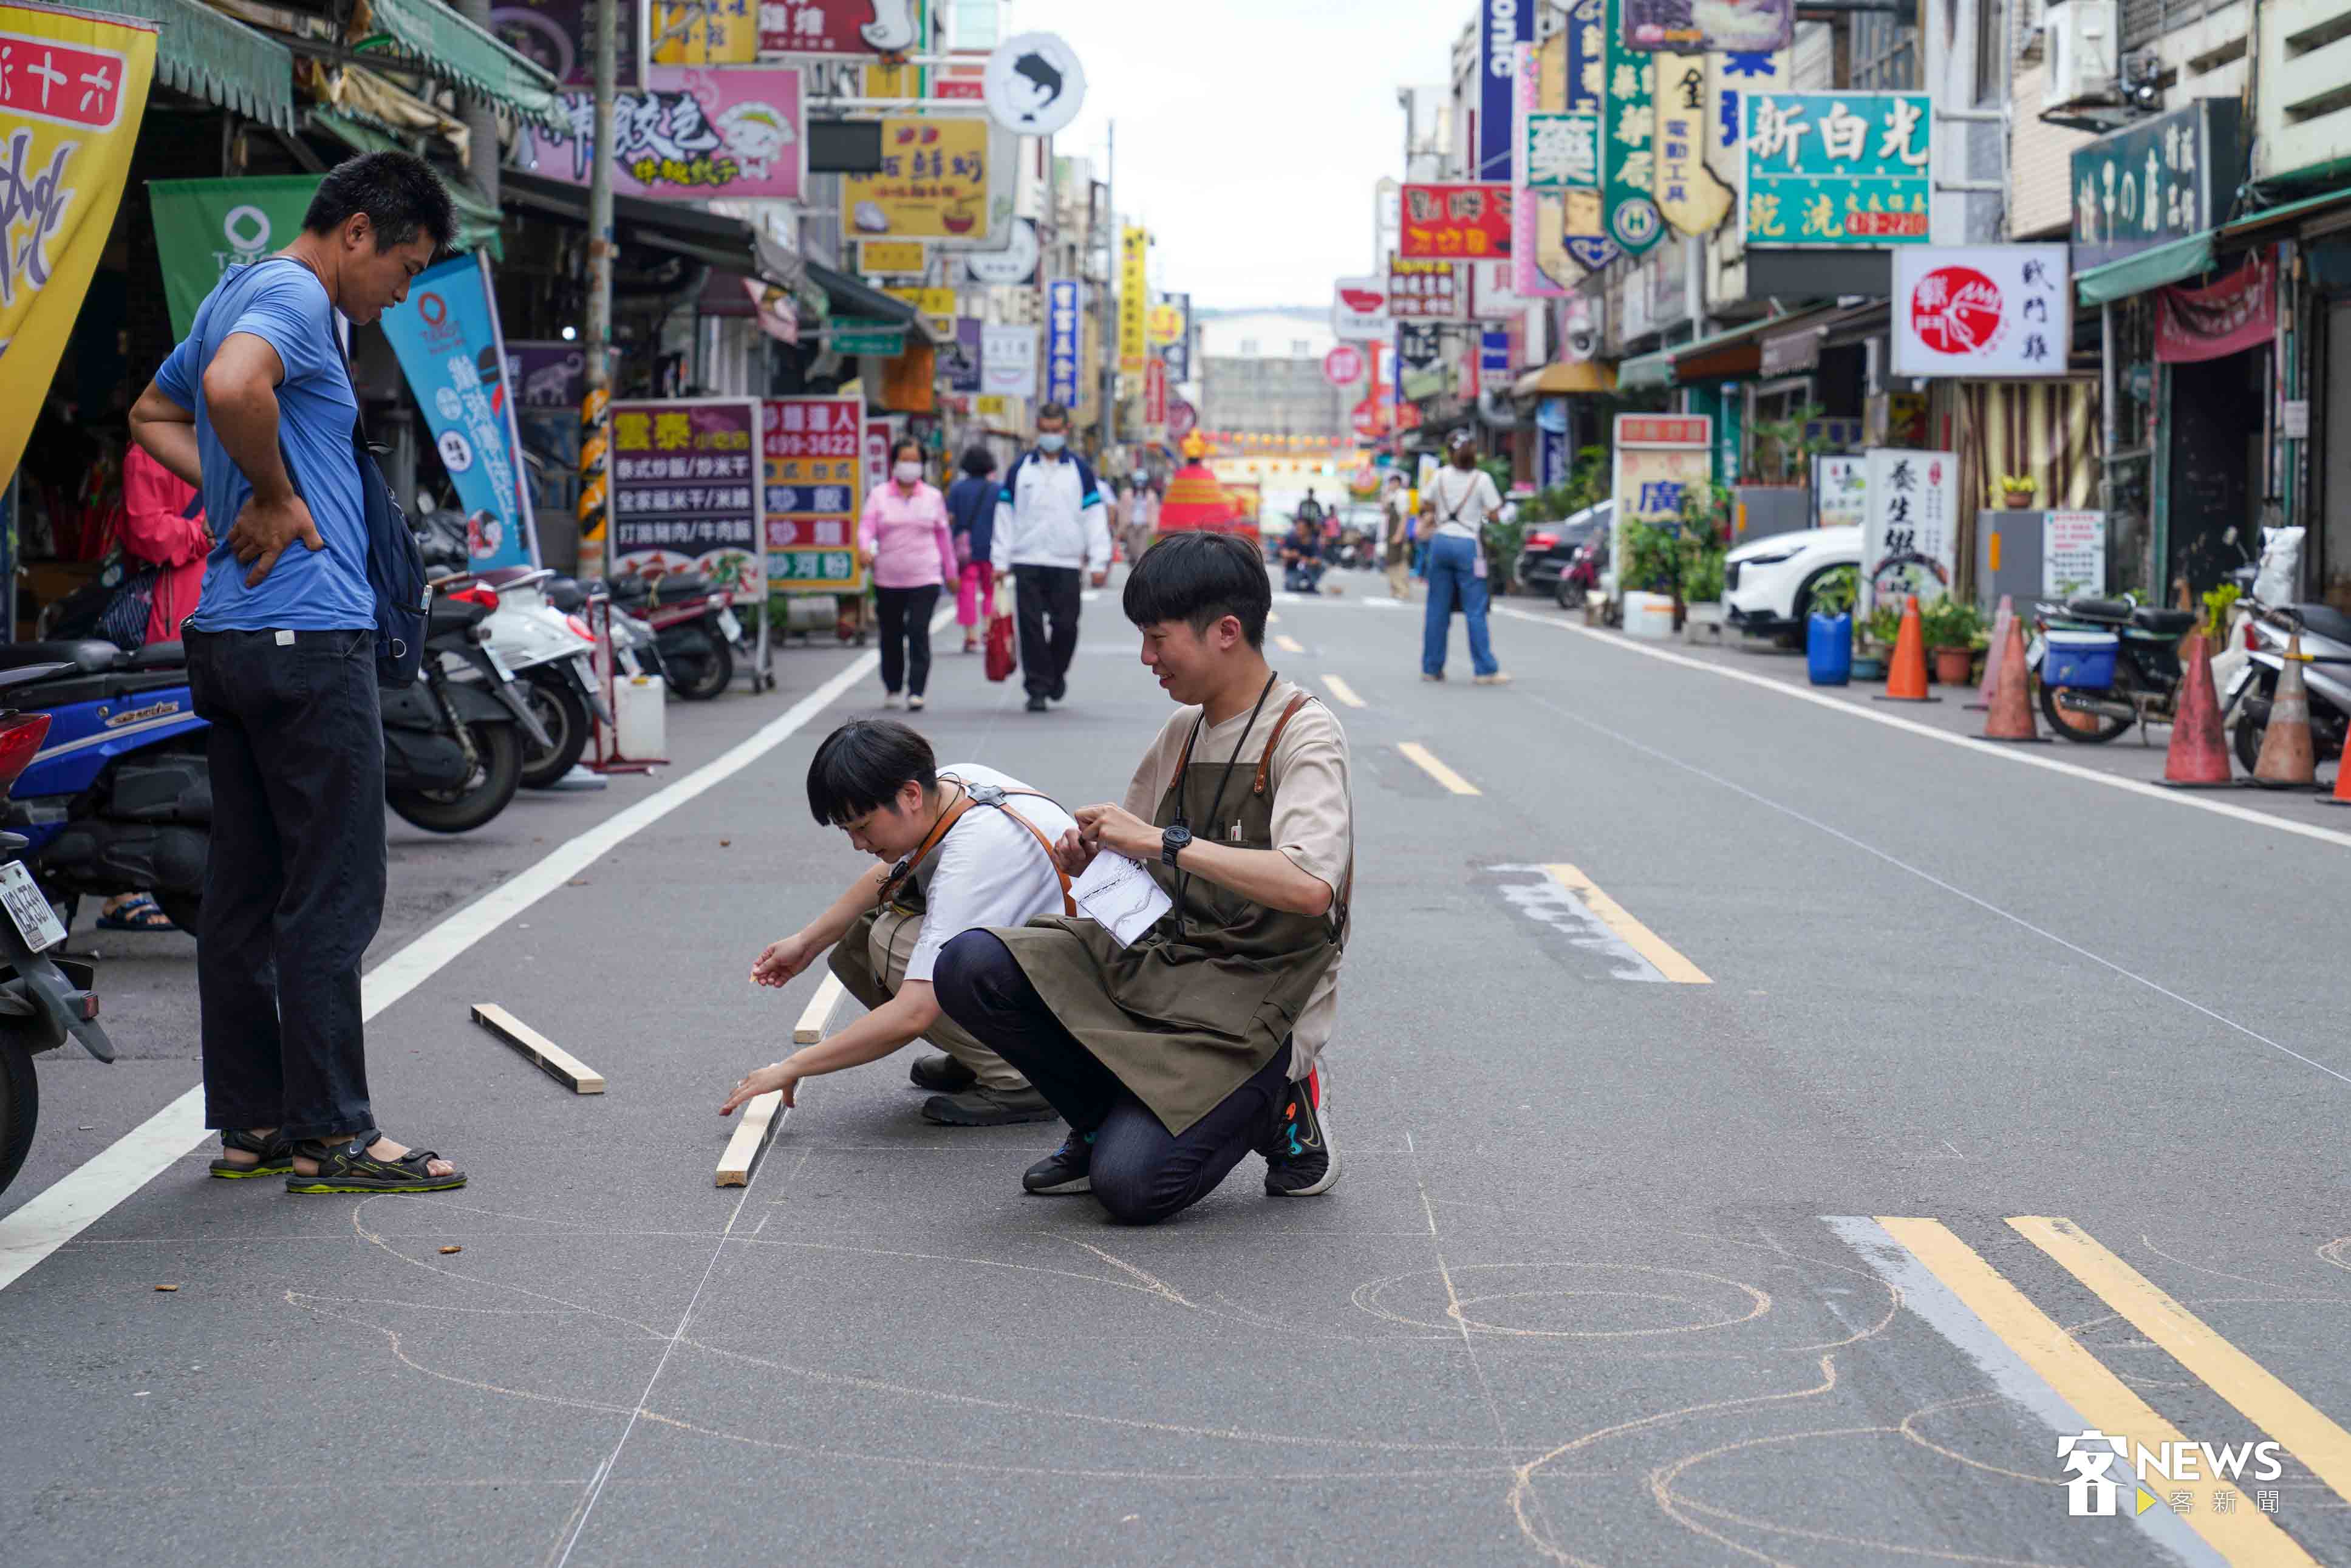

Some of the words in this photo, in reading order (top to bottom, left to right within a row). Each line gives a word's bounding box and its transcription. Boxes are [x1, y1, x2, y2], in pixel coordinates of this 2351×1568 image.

[1664, 120, 1689, 202] 電動工具
[1747, 96, 1930, 167] 新白光
[1747, 191, 1843, 237] 乾洗
